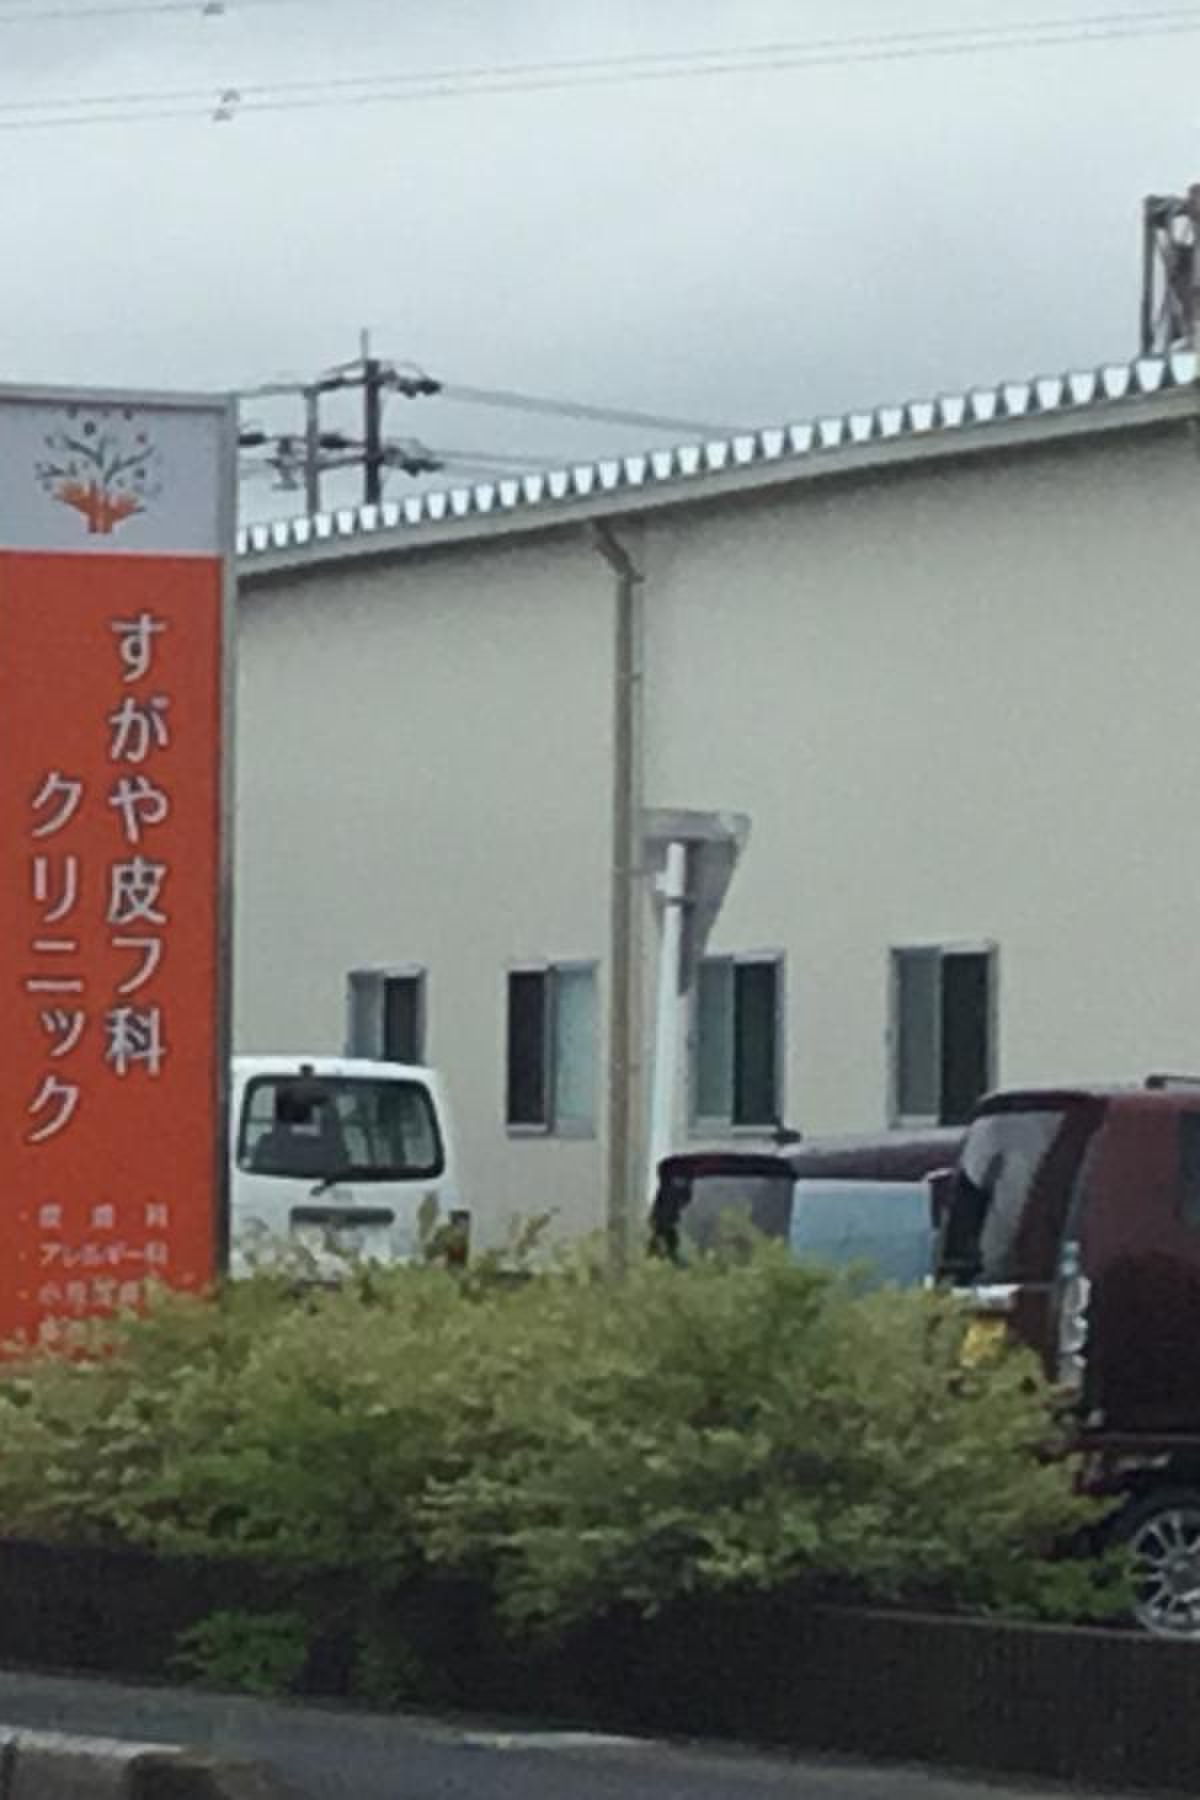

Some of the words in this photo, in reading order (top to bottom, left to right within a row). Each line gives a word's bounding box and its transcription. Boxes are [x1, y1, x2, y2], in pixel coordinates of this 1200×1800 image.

[25, 771, 85, 1142] クリニック
[106, 612, 168, 1075] すがや皮フ科
